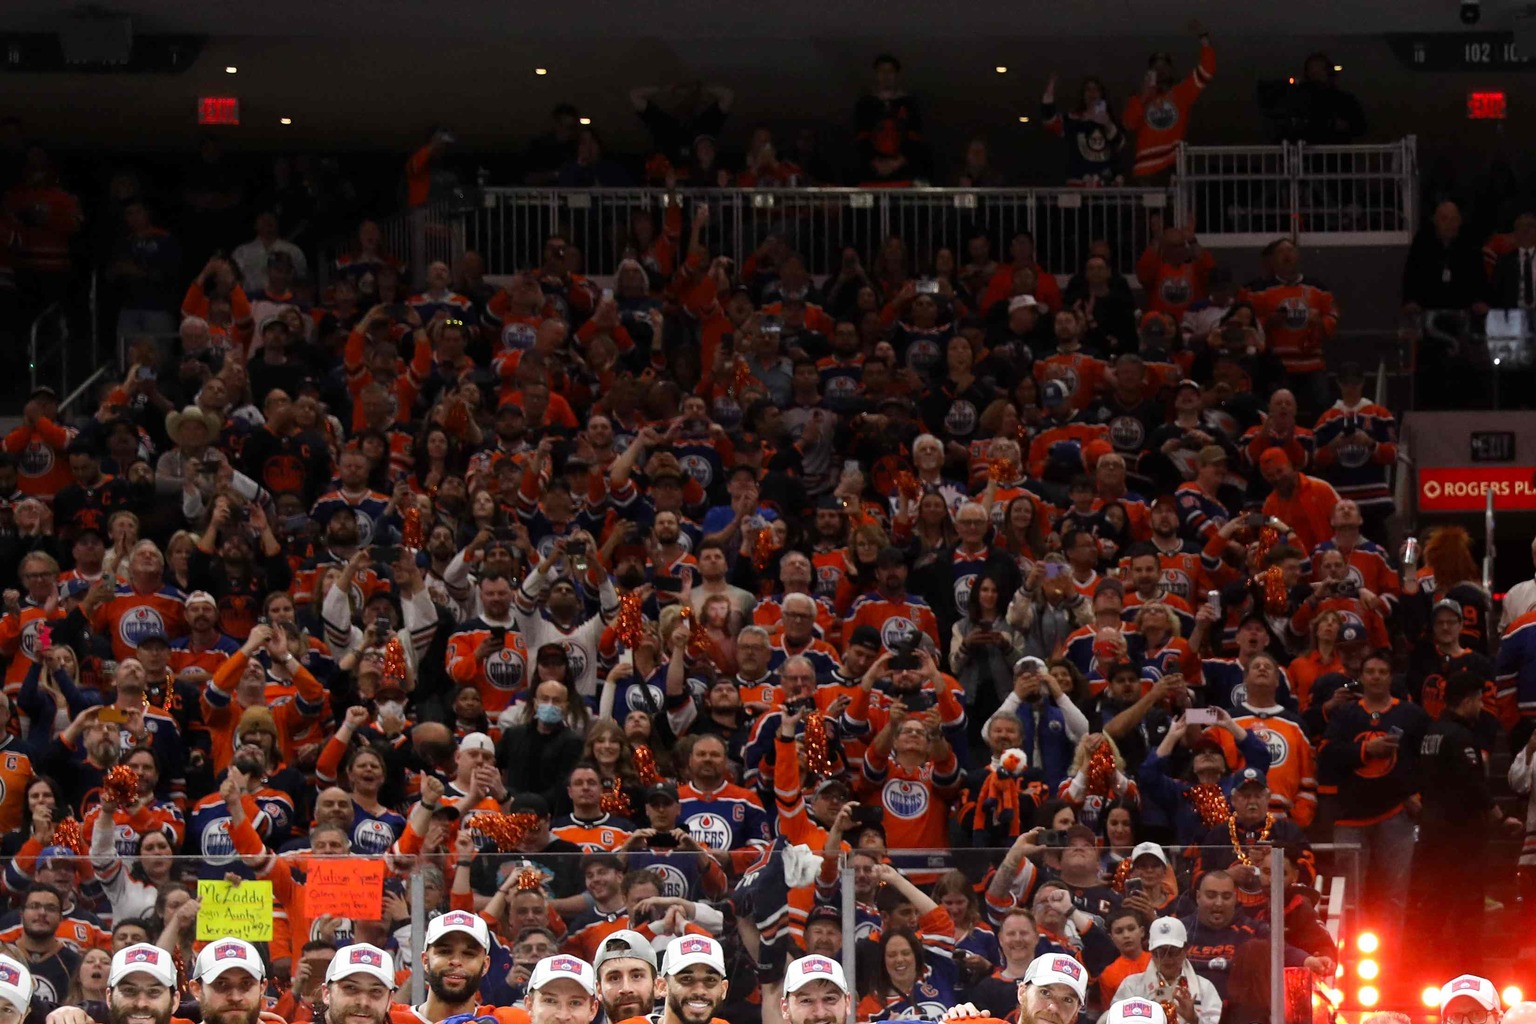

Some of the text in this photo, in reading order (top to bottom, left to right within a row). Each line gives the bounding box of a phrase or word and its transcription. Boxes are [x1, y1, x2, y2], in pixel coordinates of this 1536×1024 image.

[1464, 42, 1491, 63] 102
[1444, 480, 1511, 497] ROGERS
[491, 665, 526, 682] OILERS
[763, 688, 773, 702] C
[890, 791, 928, 807] OILERS
[733, 804, 745, 822] C
[360, 831, 393, 848] OILERS
[603, 831, 612, 845] C
[76, 924, 87, 941] C
[920, 980, 939, 997] C
